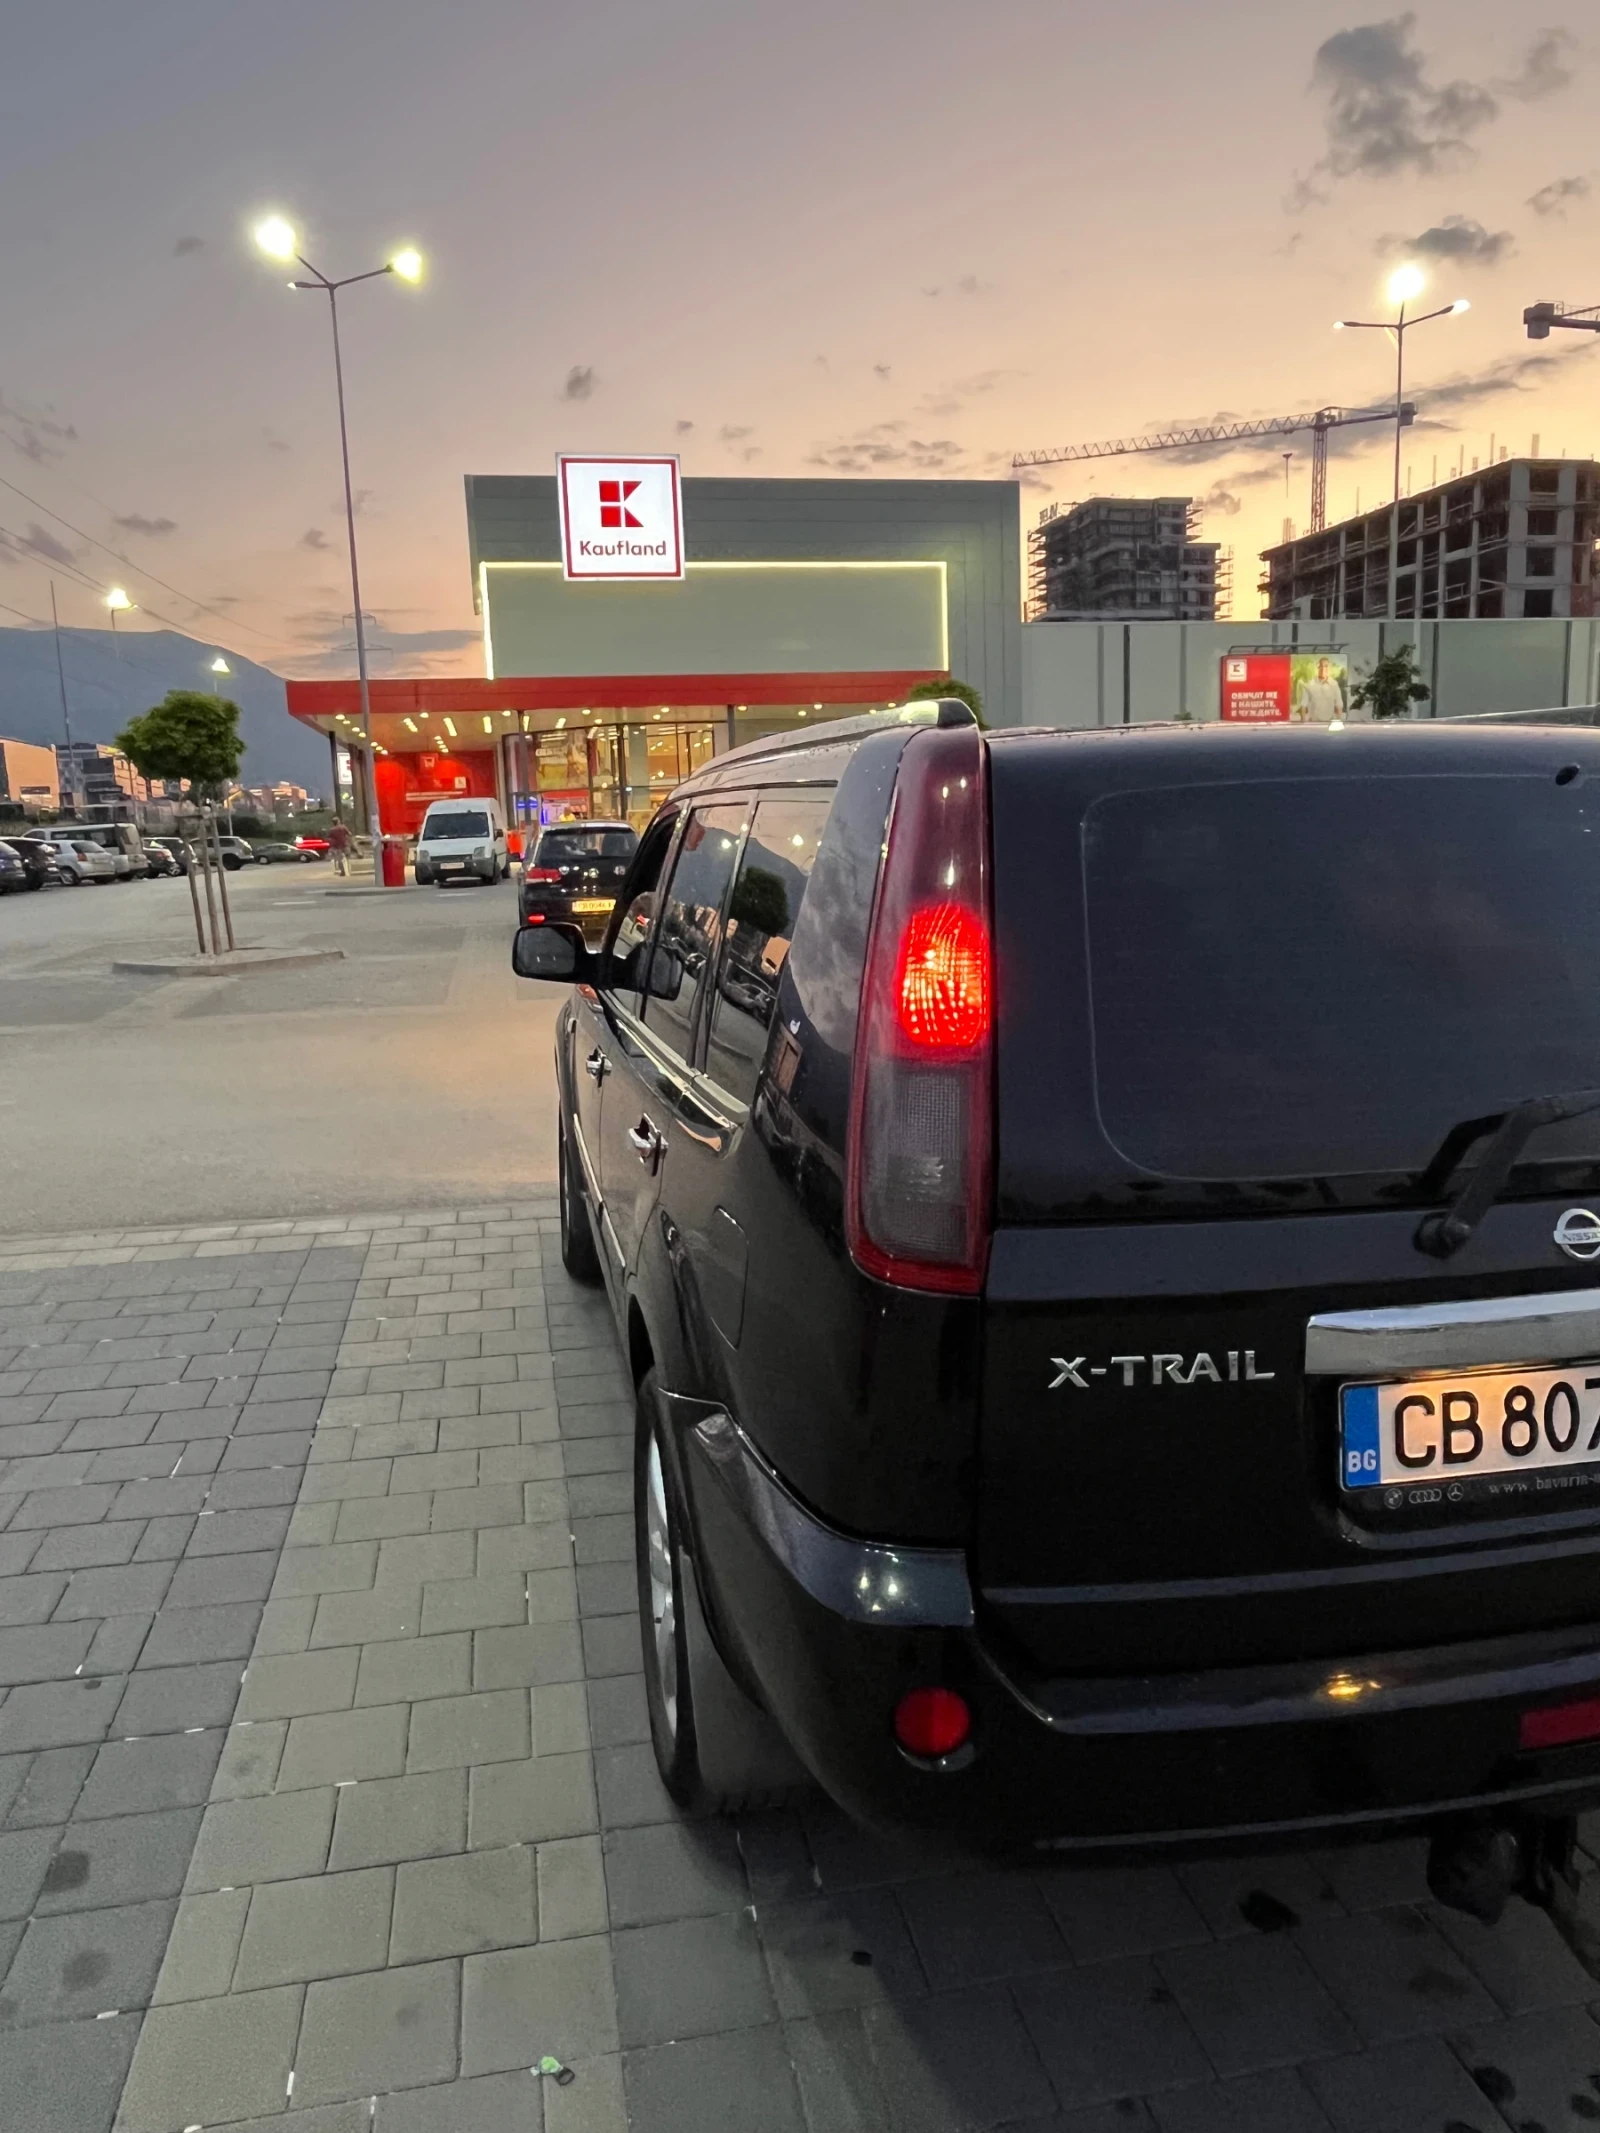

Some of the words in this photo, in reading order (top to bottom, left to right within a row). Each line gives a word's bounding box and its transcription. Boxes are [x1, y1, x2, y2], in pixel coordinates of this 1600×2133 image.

[579, 540, 667, 556] Kaufland
[1048, 1350, 1275, 1389] X-TRAIL
[1394, 1390, 1483, 1469] CB
[1347, 1449, 1377, 1473] BG
